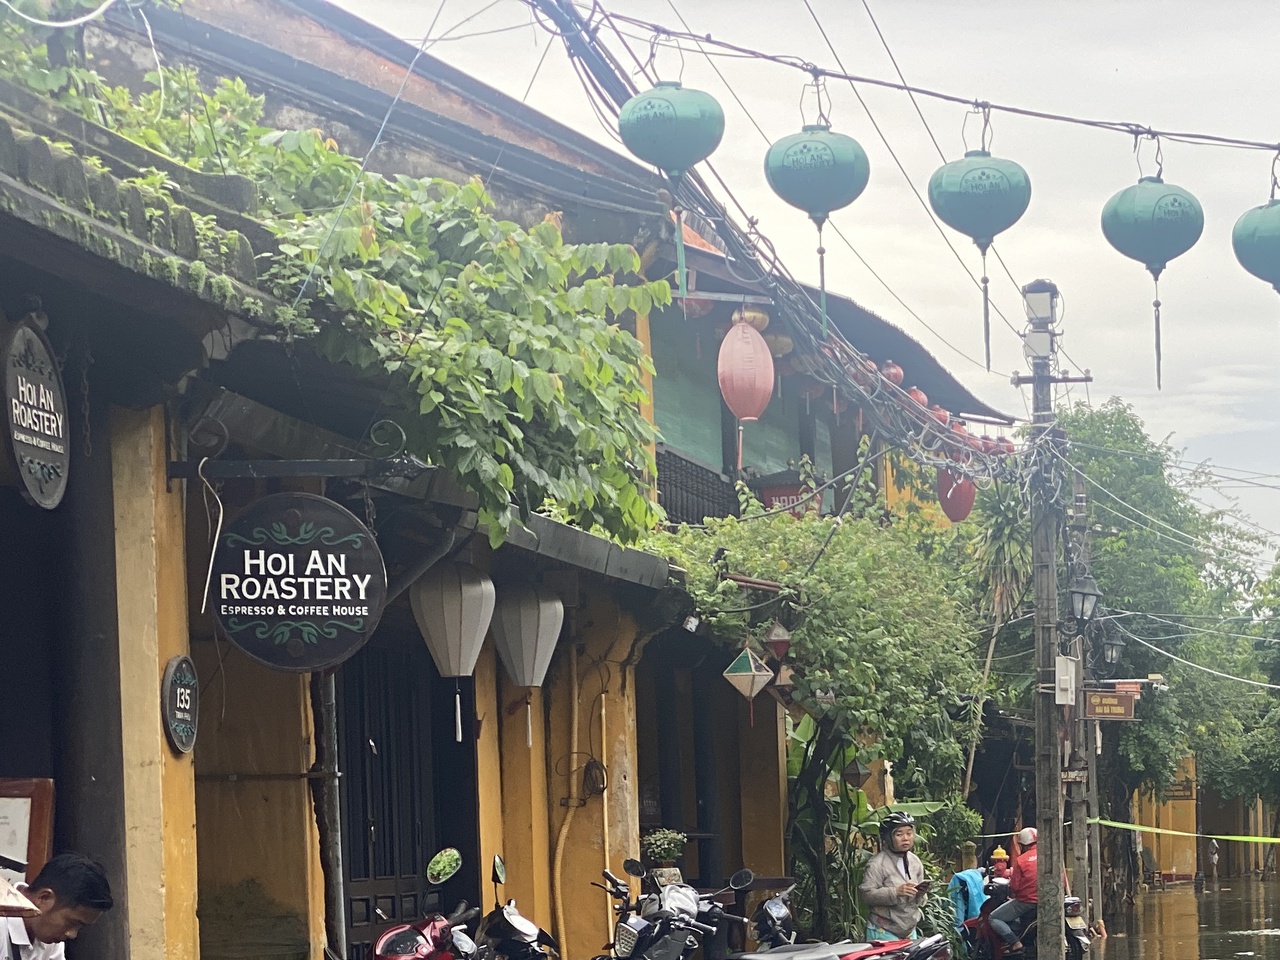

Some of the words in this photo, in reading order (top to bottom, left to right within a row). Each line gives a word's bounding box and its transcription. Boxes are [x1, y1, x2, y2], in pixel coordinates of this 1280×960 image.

[792, 155, 807, 166] HOI
[810, 154, 823, 163] AN
[970, 183, 987, 191] HOI
[17, 375, 37, 406] HOI
[39, 383, 54, 412] AN
[12, 398, 63, 438] ROASTERY
[243, 549, 295, 576] HOI
[304, 549, 346, 576] AN
[220, 573, 372, 600] ROASTERY
[221, 604, 274, 615] ESPRESSO
[277, 605, 286, 615] &
[288, 605, 330, 616] COFFEE
[332, 605, 369, 616] HOUSE
[176, 687, 191, 710] 135
